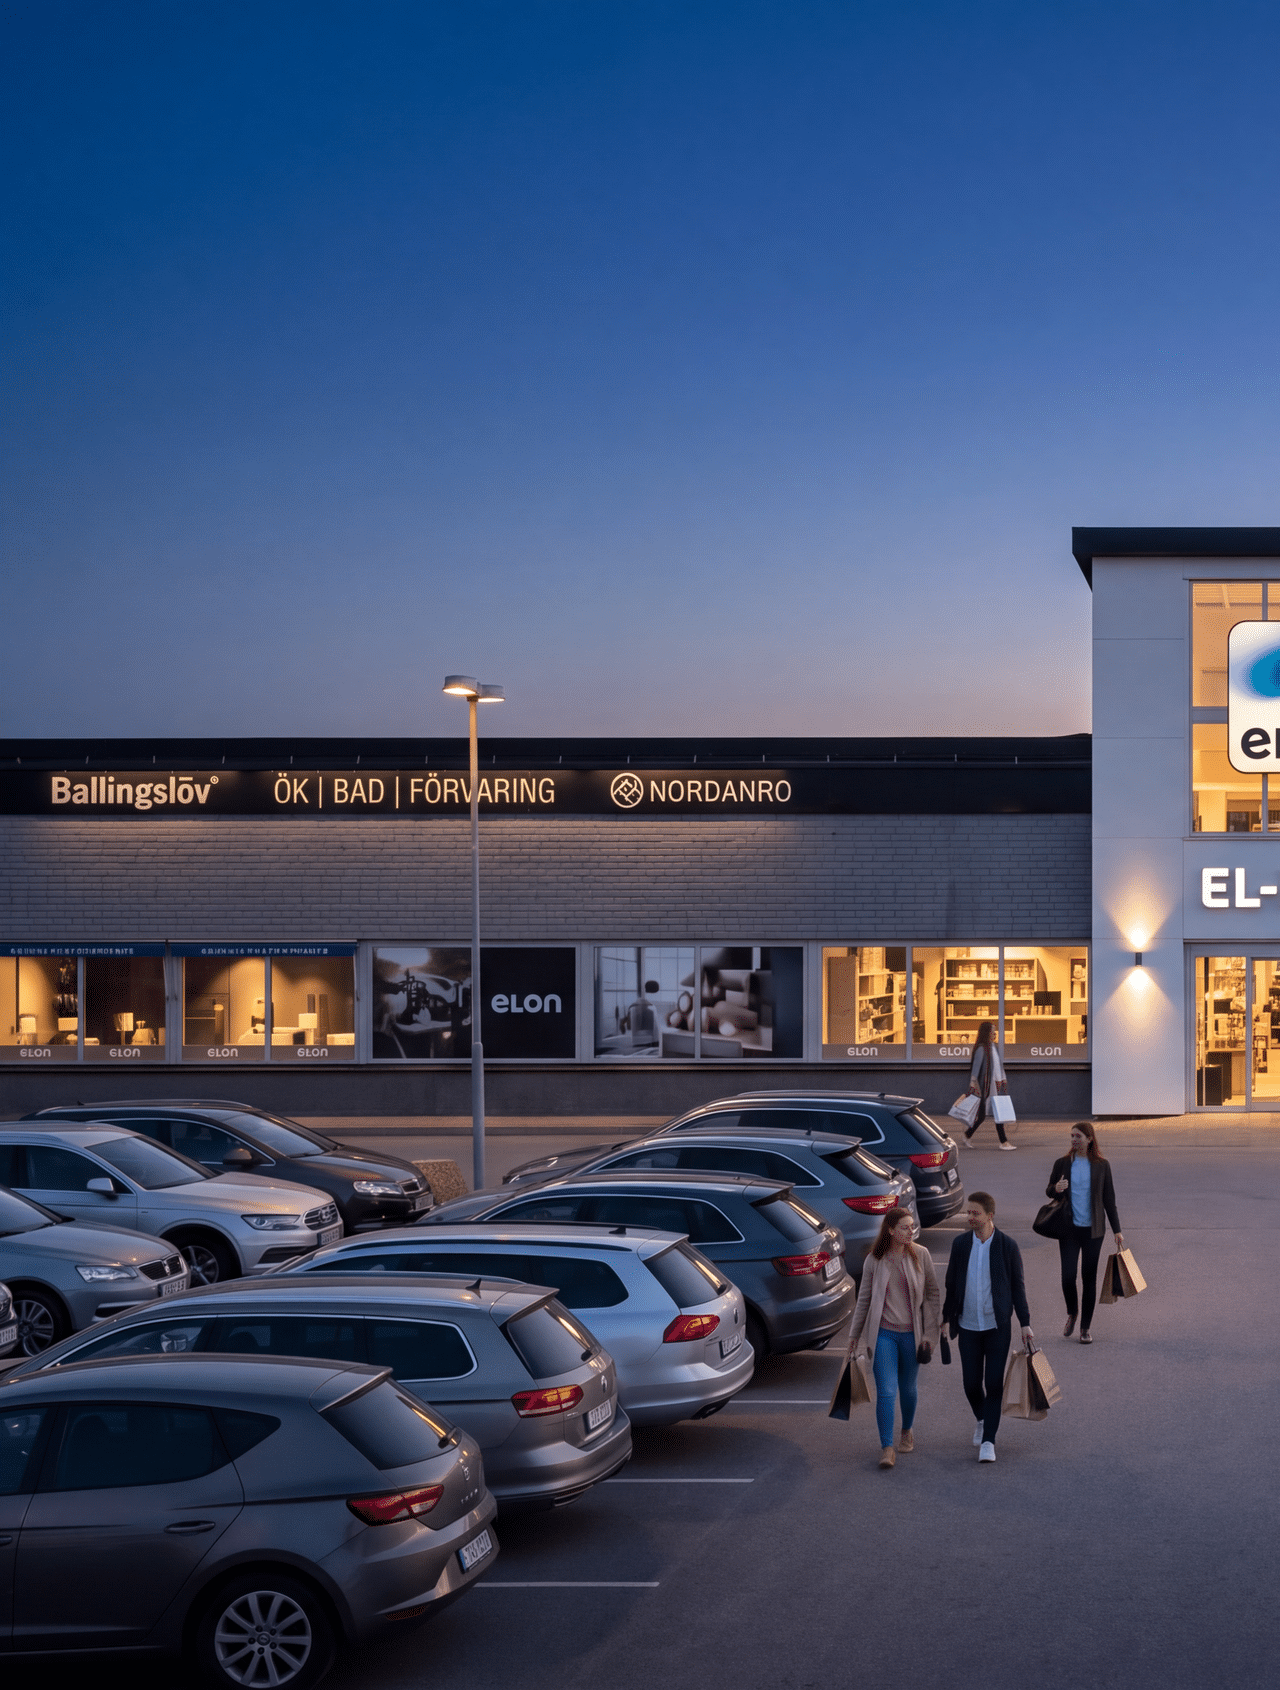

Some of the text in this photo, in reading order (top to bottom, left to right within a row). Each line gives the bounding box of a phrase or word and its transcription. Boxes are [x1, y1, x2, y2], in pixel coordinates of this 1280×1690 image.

[274, 772, 555, 804] ÖK BAD FÖRVARING
[650, 779, 792, 803] NORDANRO
